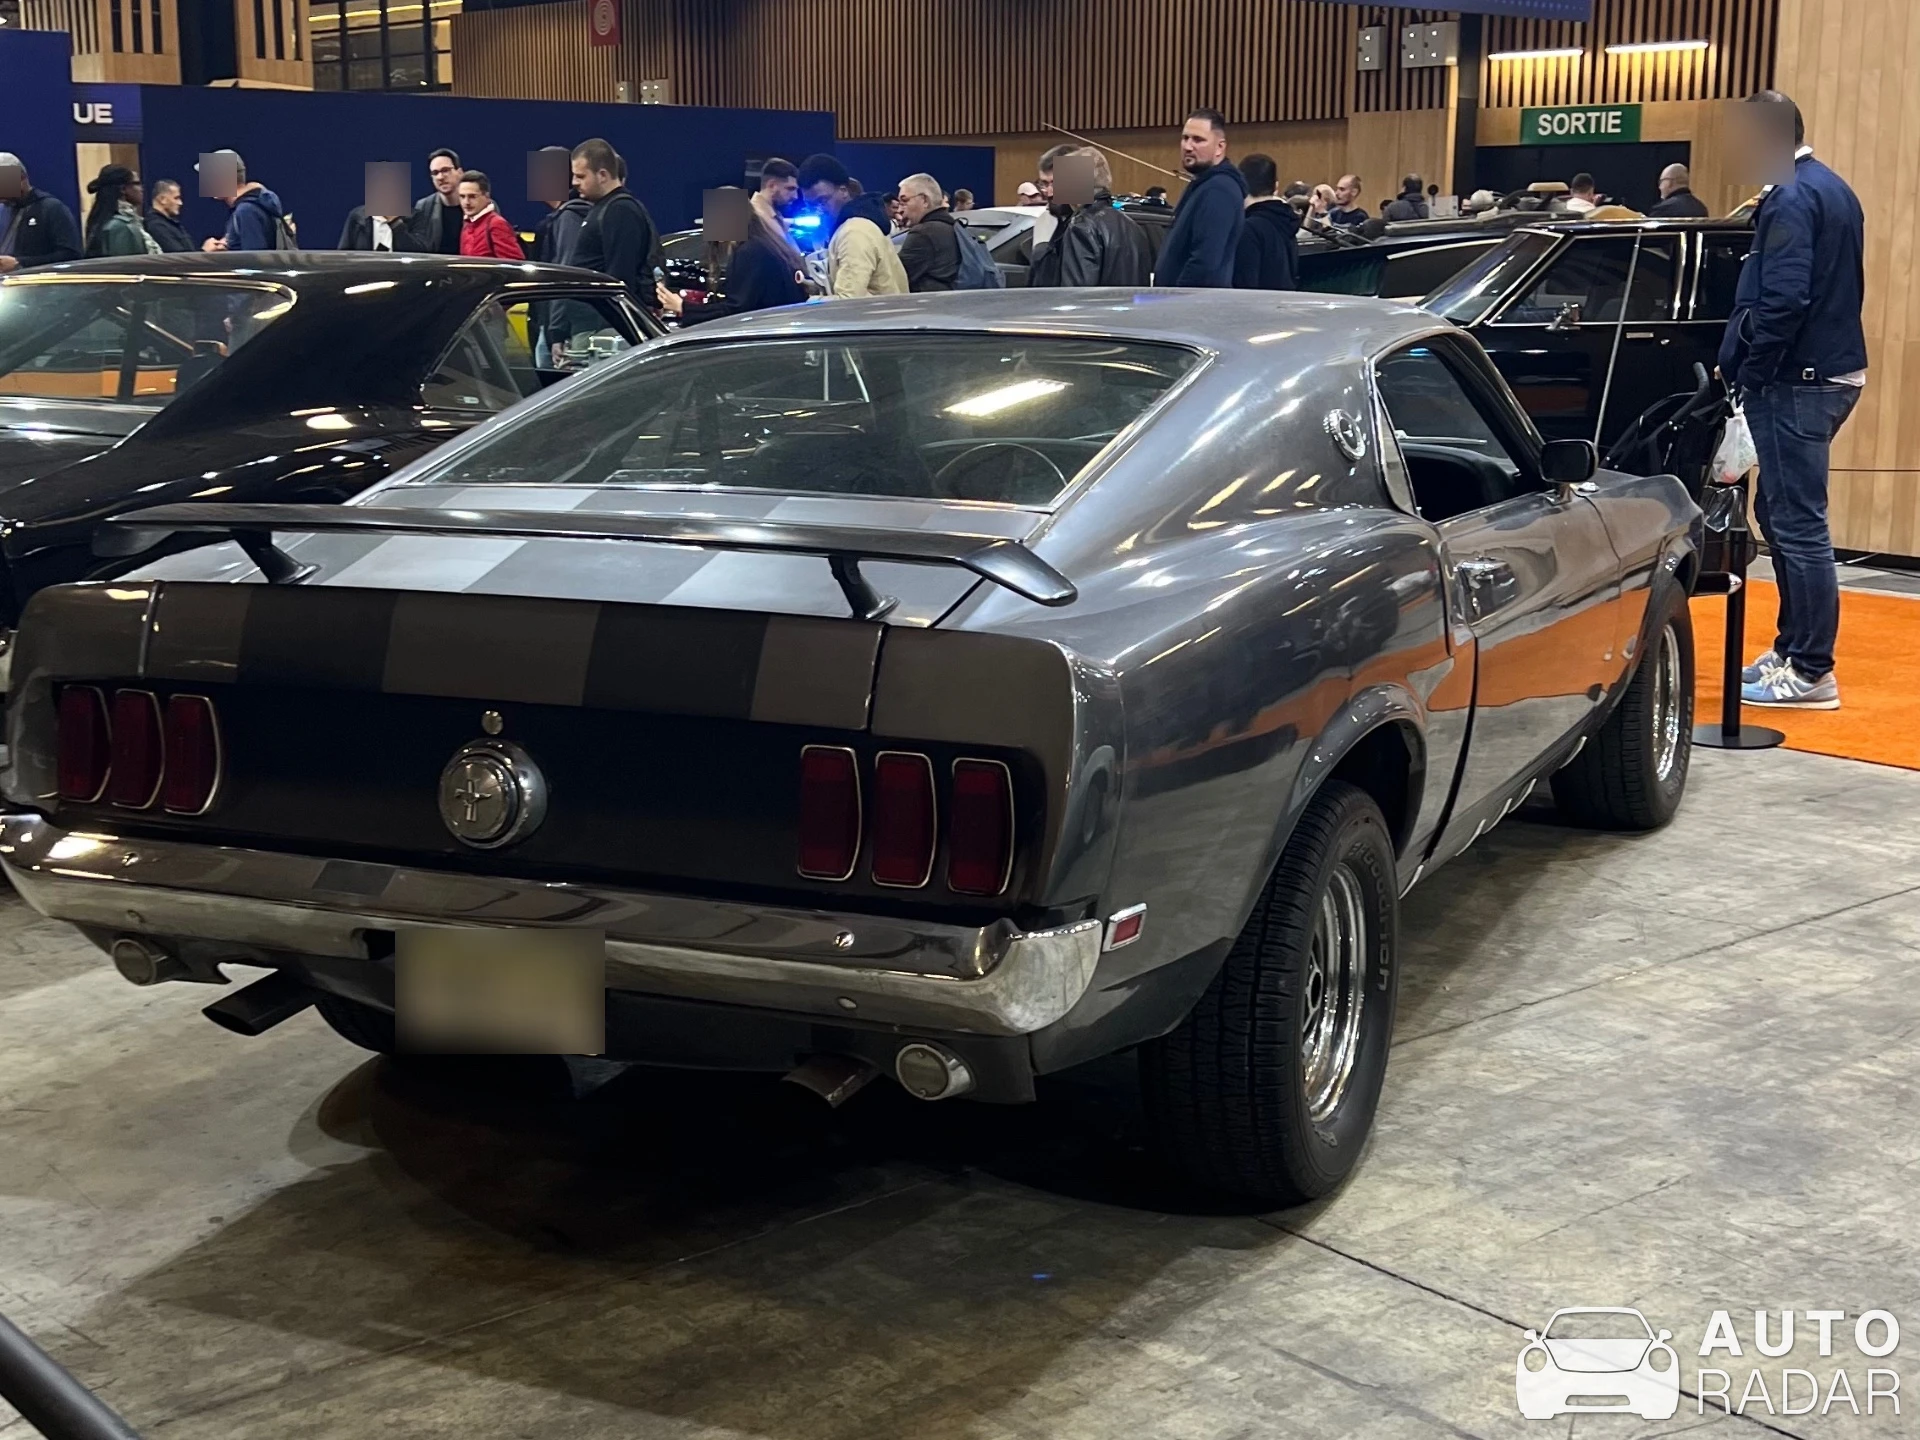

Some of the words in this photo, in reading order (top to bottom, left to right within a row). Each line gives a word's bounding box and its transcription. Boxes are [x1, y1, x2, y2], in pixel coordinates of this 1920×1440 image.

[73, 103, 113, 124] UE
[1537, 111, 1622, 136] SORTIE
[1771, 682, 1794, 700] N
